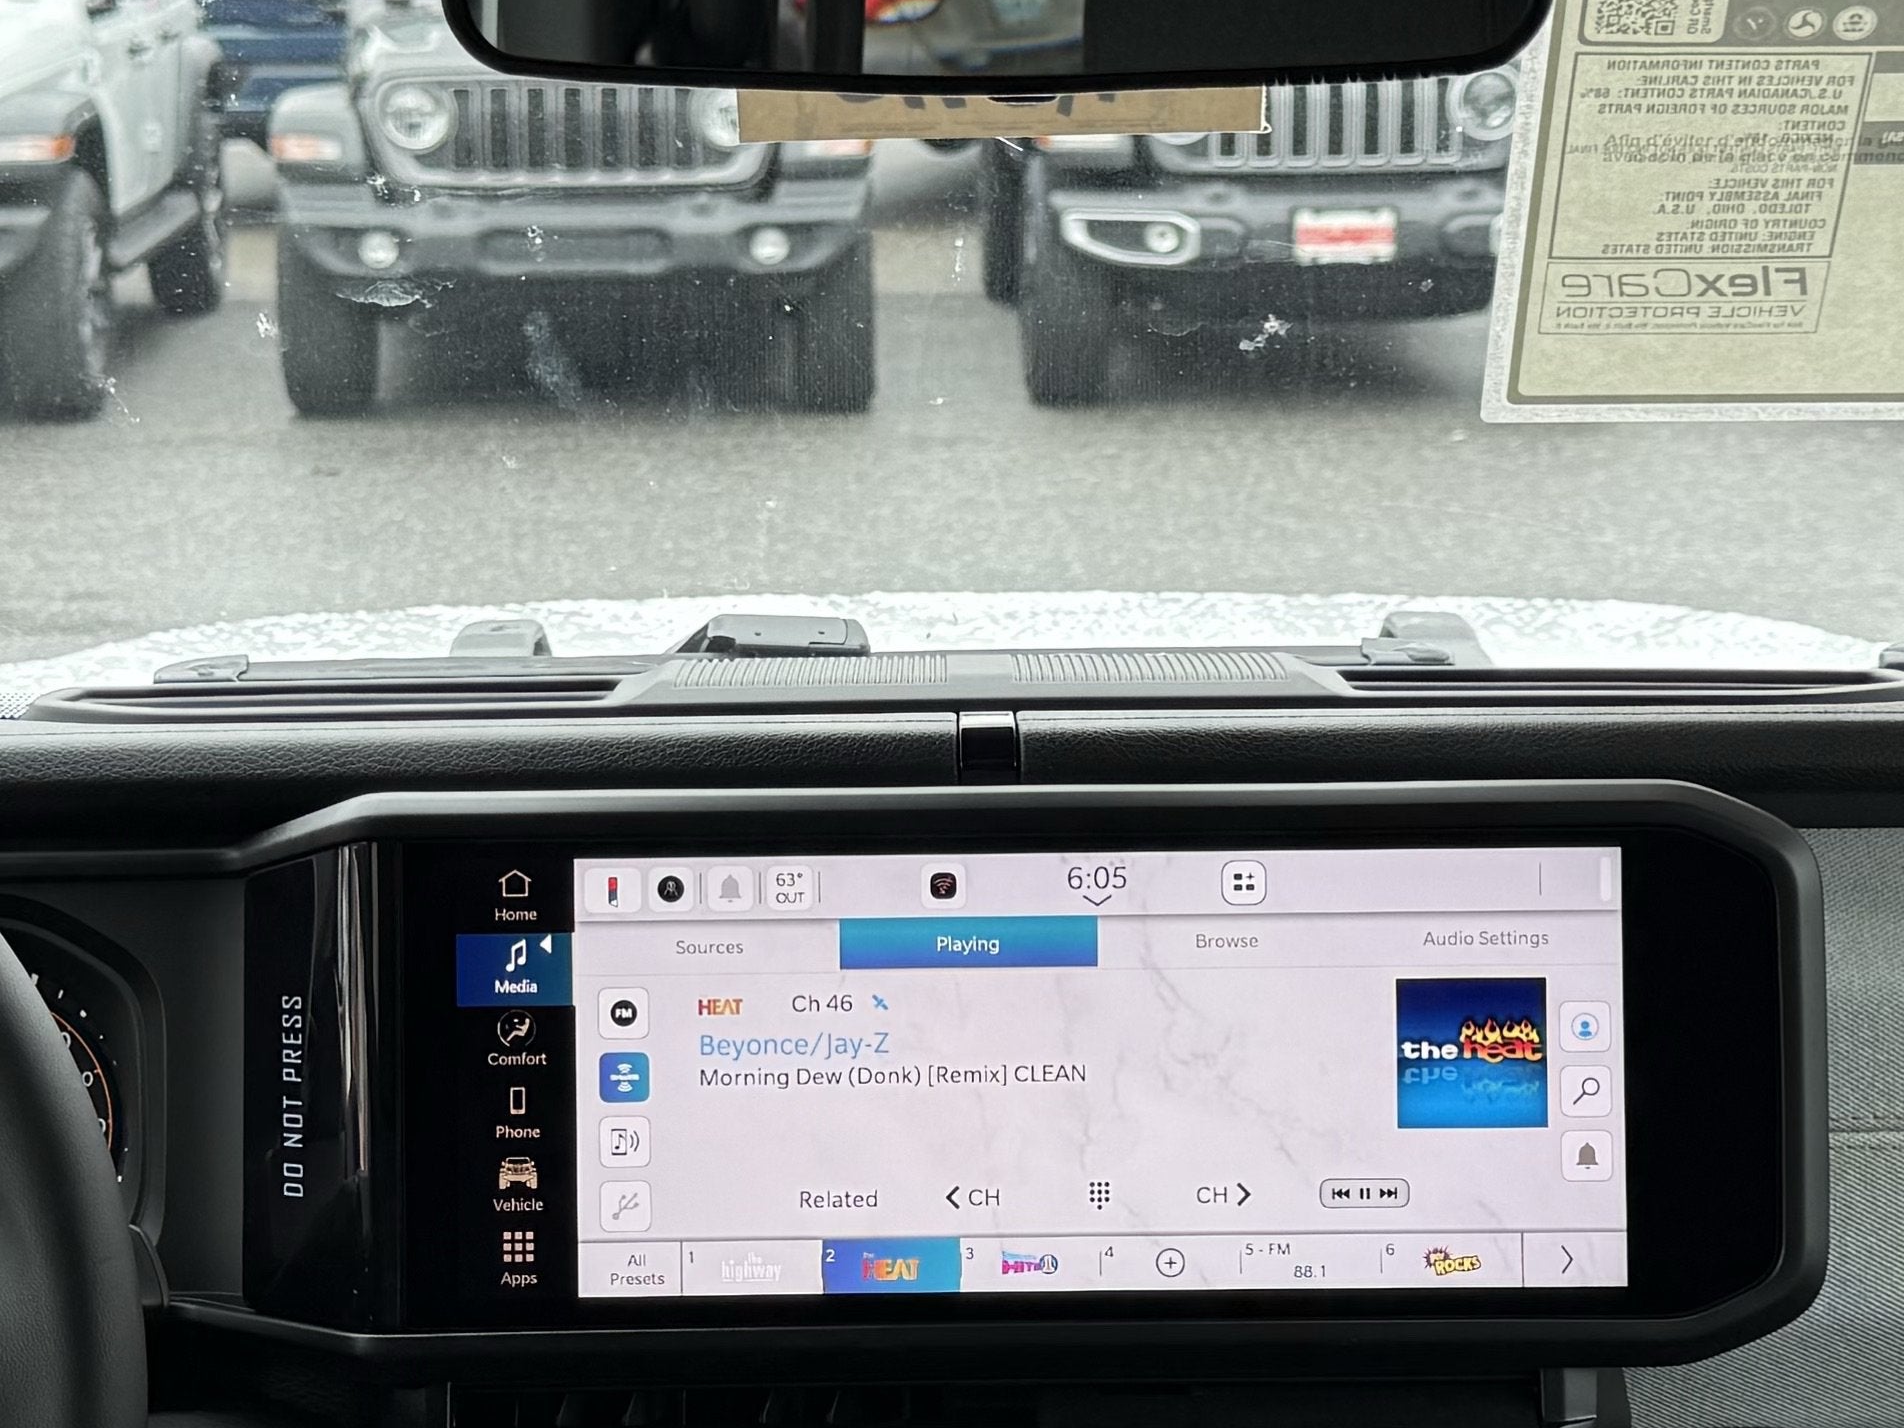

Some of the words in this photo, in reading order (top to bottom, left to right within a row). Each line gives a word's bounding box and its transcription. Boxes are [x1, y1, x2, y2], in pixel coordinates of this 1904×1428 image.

[775, 872, 803, 887] 63°
[1067, 865, 1128, 891] 6:05
[775, 891, 805, 905] OUT
[494, 908, 538, 922] Home
[675, 940, 744, 955] Sources
[936, 936, 1000, 955] Playing
[1195, 933, 1259, 949] Browse
[1423, 930, 1475, 946] Audio
[1478, 929, 1549, 949] Settings
[494, 979, 538, 994] Media
[698, 998, 743, 1016] HEAT
[791, 994, 823, 1014] Ch
[826, 994, 853, 1012] 46
[282, 996, 302, 1082] PRESS
[699, 1032, 890, 1063] Beyonce/Jay-Z
[487, 1052, 547, 1066] Comfort
[1401, 1040, 1458, 1061] the
[1462, 1038, 1543, 1064] heat
[699, 1067, 790, 1090] Morning
[796, 1067, 842, 1086] Dew
[848, 1065, 921, 1088] (Donk)
[928, 1064, 1008, 1086] [Remix]
[1014, 1063, 1087, 1083] CLEAN
[283, 1096, 303, 1147] NOT
[495, 1124, 541, 1140] Phone
[284, 1163, 303, 1197] DO
[799, 1189, 878, 1210] Related
[968, 1188, 1000, 1207] CH
[1196, 1186, 1229, 1204] CH
[493, 1198, 544, 1212] Vehicle
[627, 1254, 647, 1267] All
[1434, 1254, 1481, 1275] ROCKS
[501, 1272, 538, 1288] Apps
[610, 1272, 666, 1286] Presets
[721, 1260, 782, 1283] highway
[1293, 1265, 1327, 1279] 88.1
